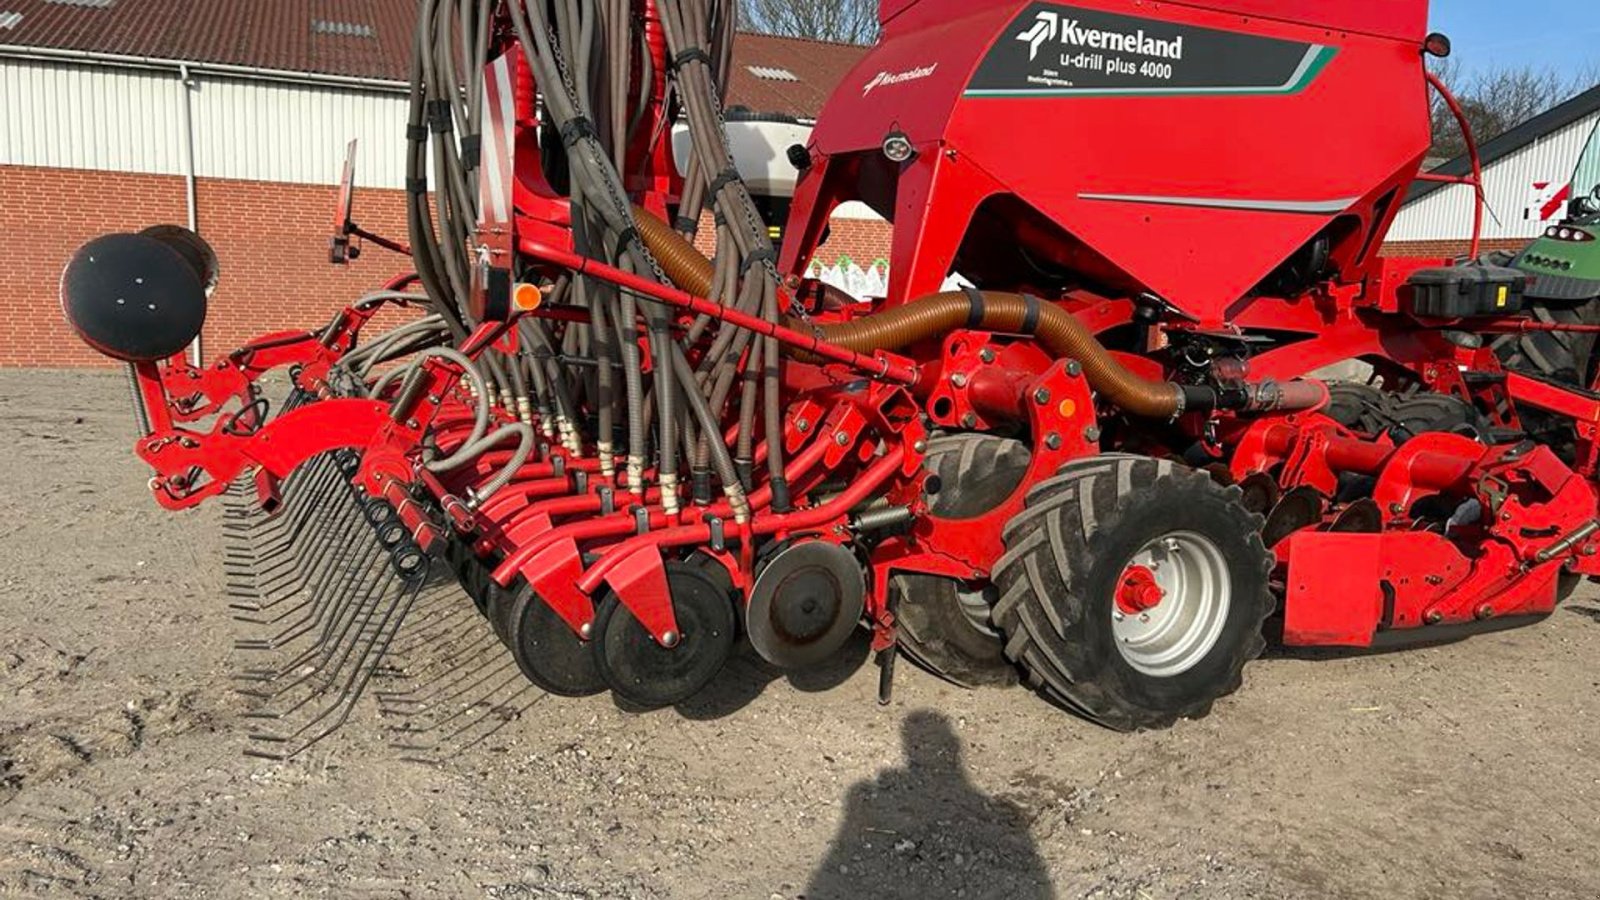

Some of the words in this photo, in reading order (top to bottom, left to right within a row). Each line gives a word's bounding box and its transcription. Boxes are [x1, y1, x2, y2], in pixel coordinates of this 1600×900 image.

[1060, 18, 1183, 60] Kverneland
[879, 62, 938, 86] Kverneland
[1060, 53, 1103, 70] u-drill
[1106, 57, 1137, 75] plus
[1140, 61, 1172, 79] 4000
